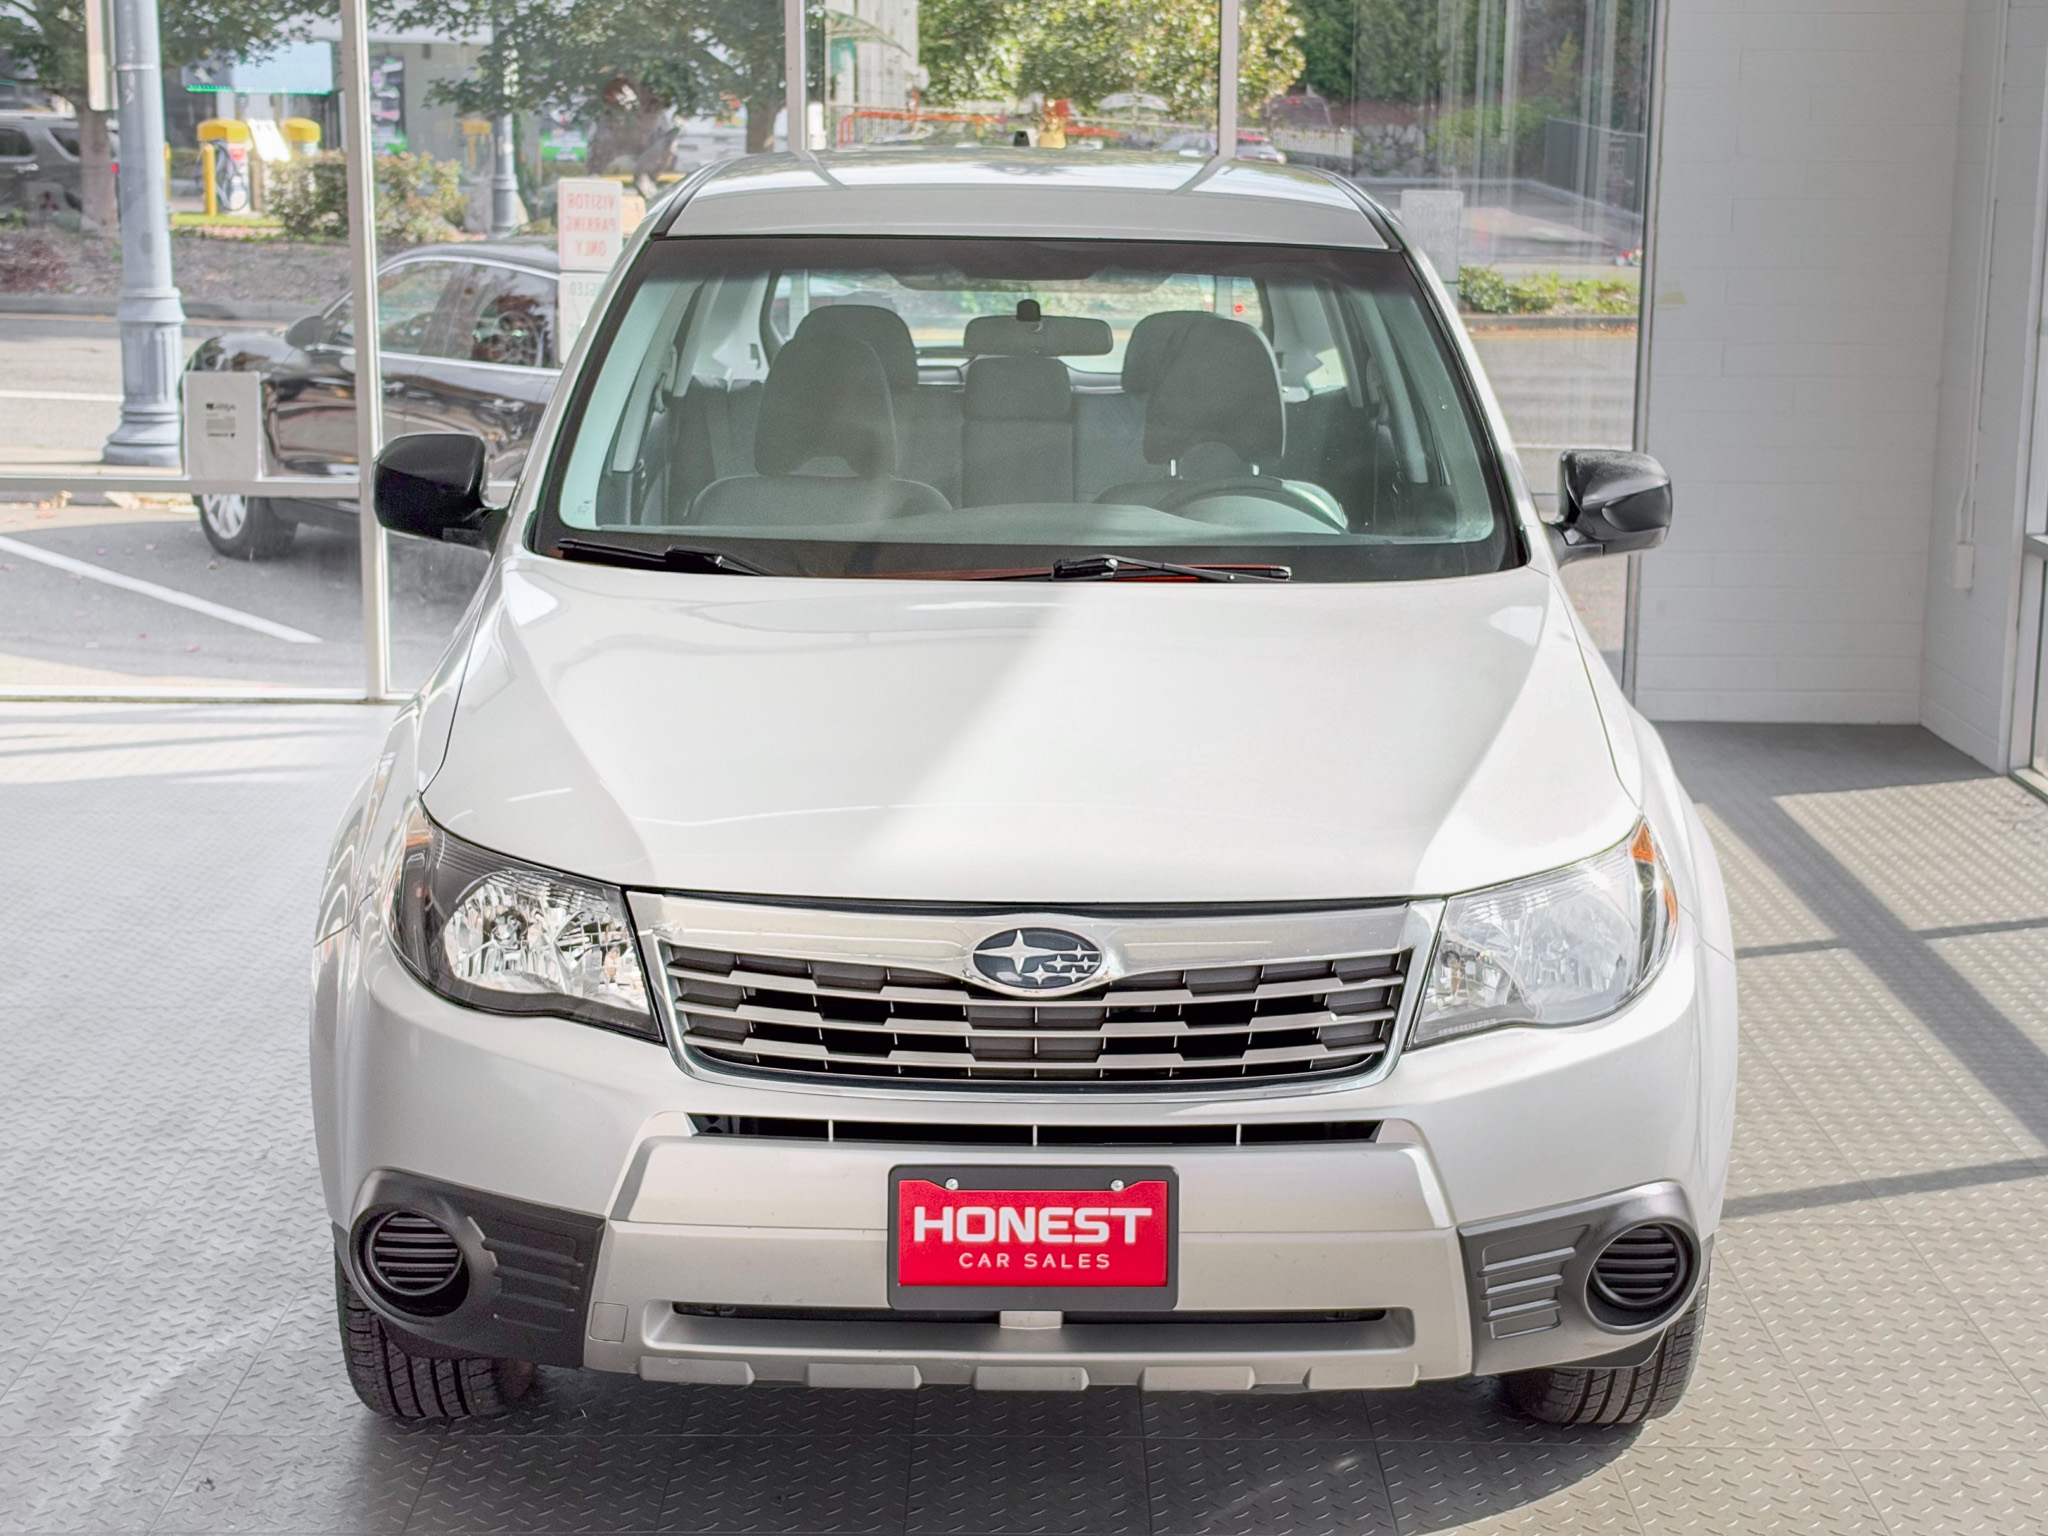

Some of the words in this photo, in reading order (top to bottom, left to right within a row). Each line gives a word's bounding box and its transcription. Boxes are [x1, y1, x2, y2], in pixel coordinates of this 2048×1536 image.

[914, 1206, 1153, 1244] HONEST
[958, 1252, 1010, 1269] CAR
[1024, 1252, 1110, 1269] SALES
